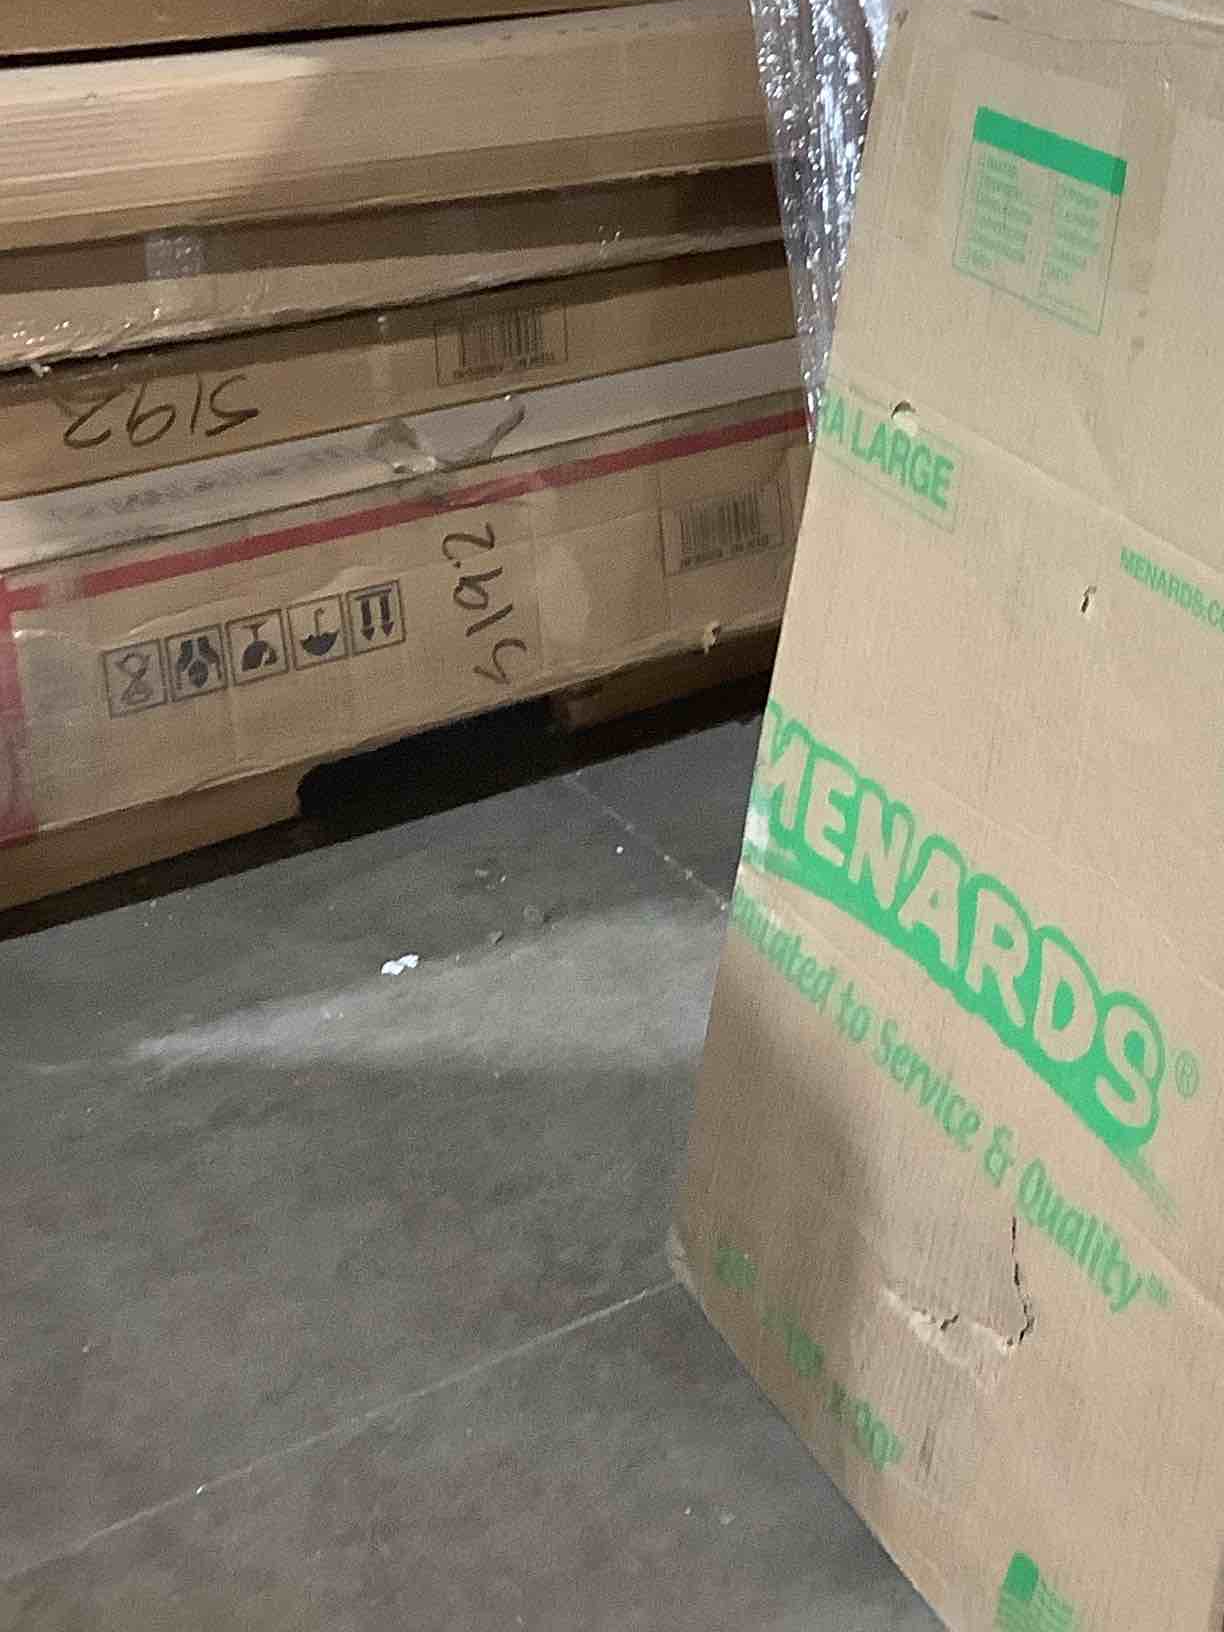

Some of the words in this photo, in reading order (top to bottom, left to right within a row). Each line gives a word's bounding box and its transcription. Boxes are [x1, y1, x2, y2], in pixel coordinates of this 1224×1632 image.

[61, 372, 261, 451] 5192
[850, 408, 955, 510] LARGE
[750, 698, 1168, 1153] MENARDS
[836, 980, 872, 1043] to
[874, 1016, 983, 1150] Service
[984, 1125, 1018, 1184] &
[1015, 1156, 1146, 1313] Quality
